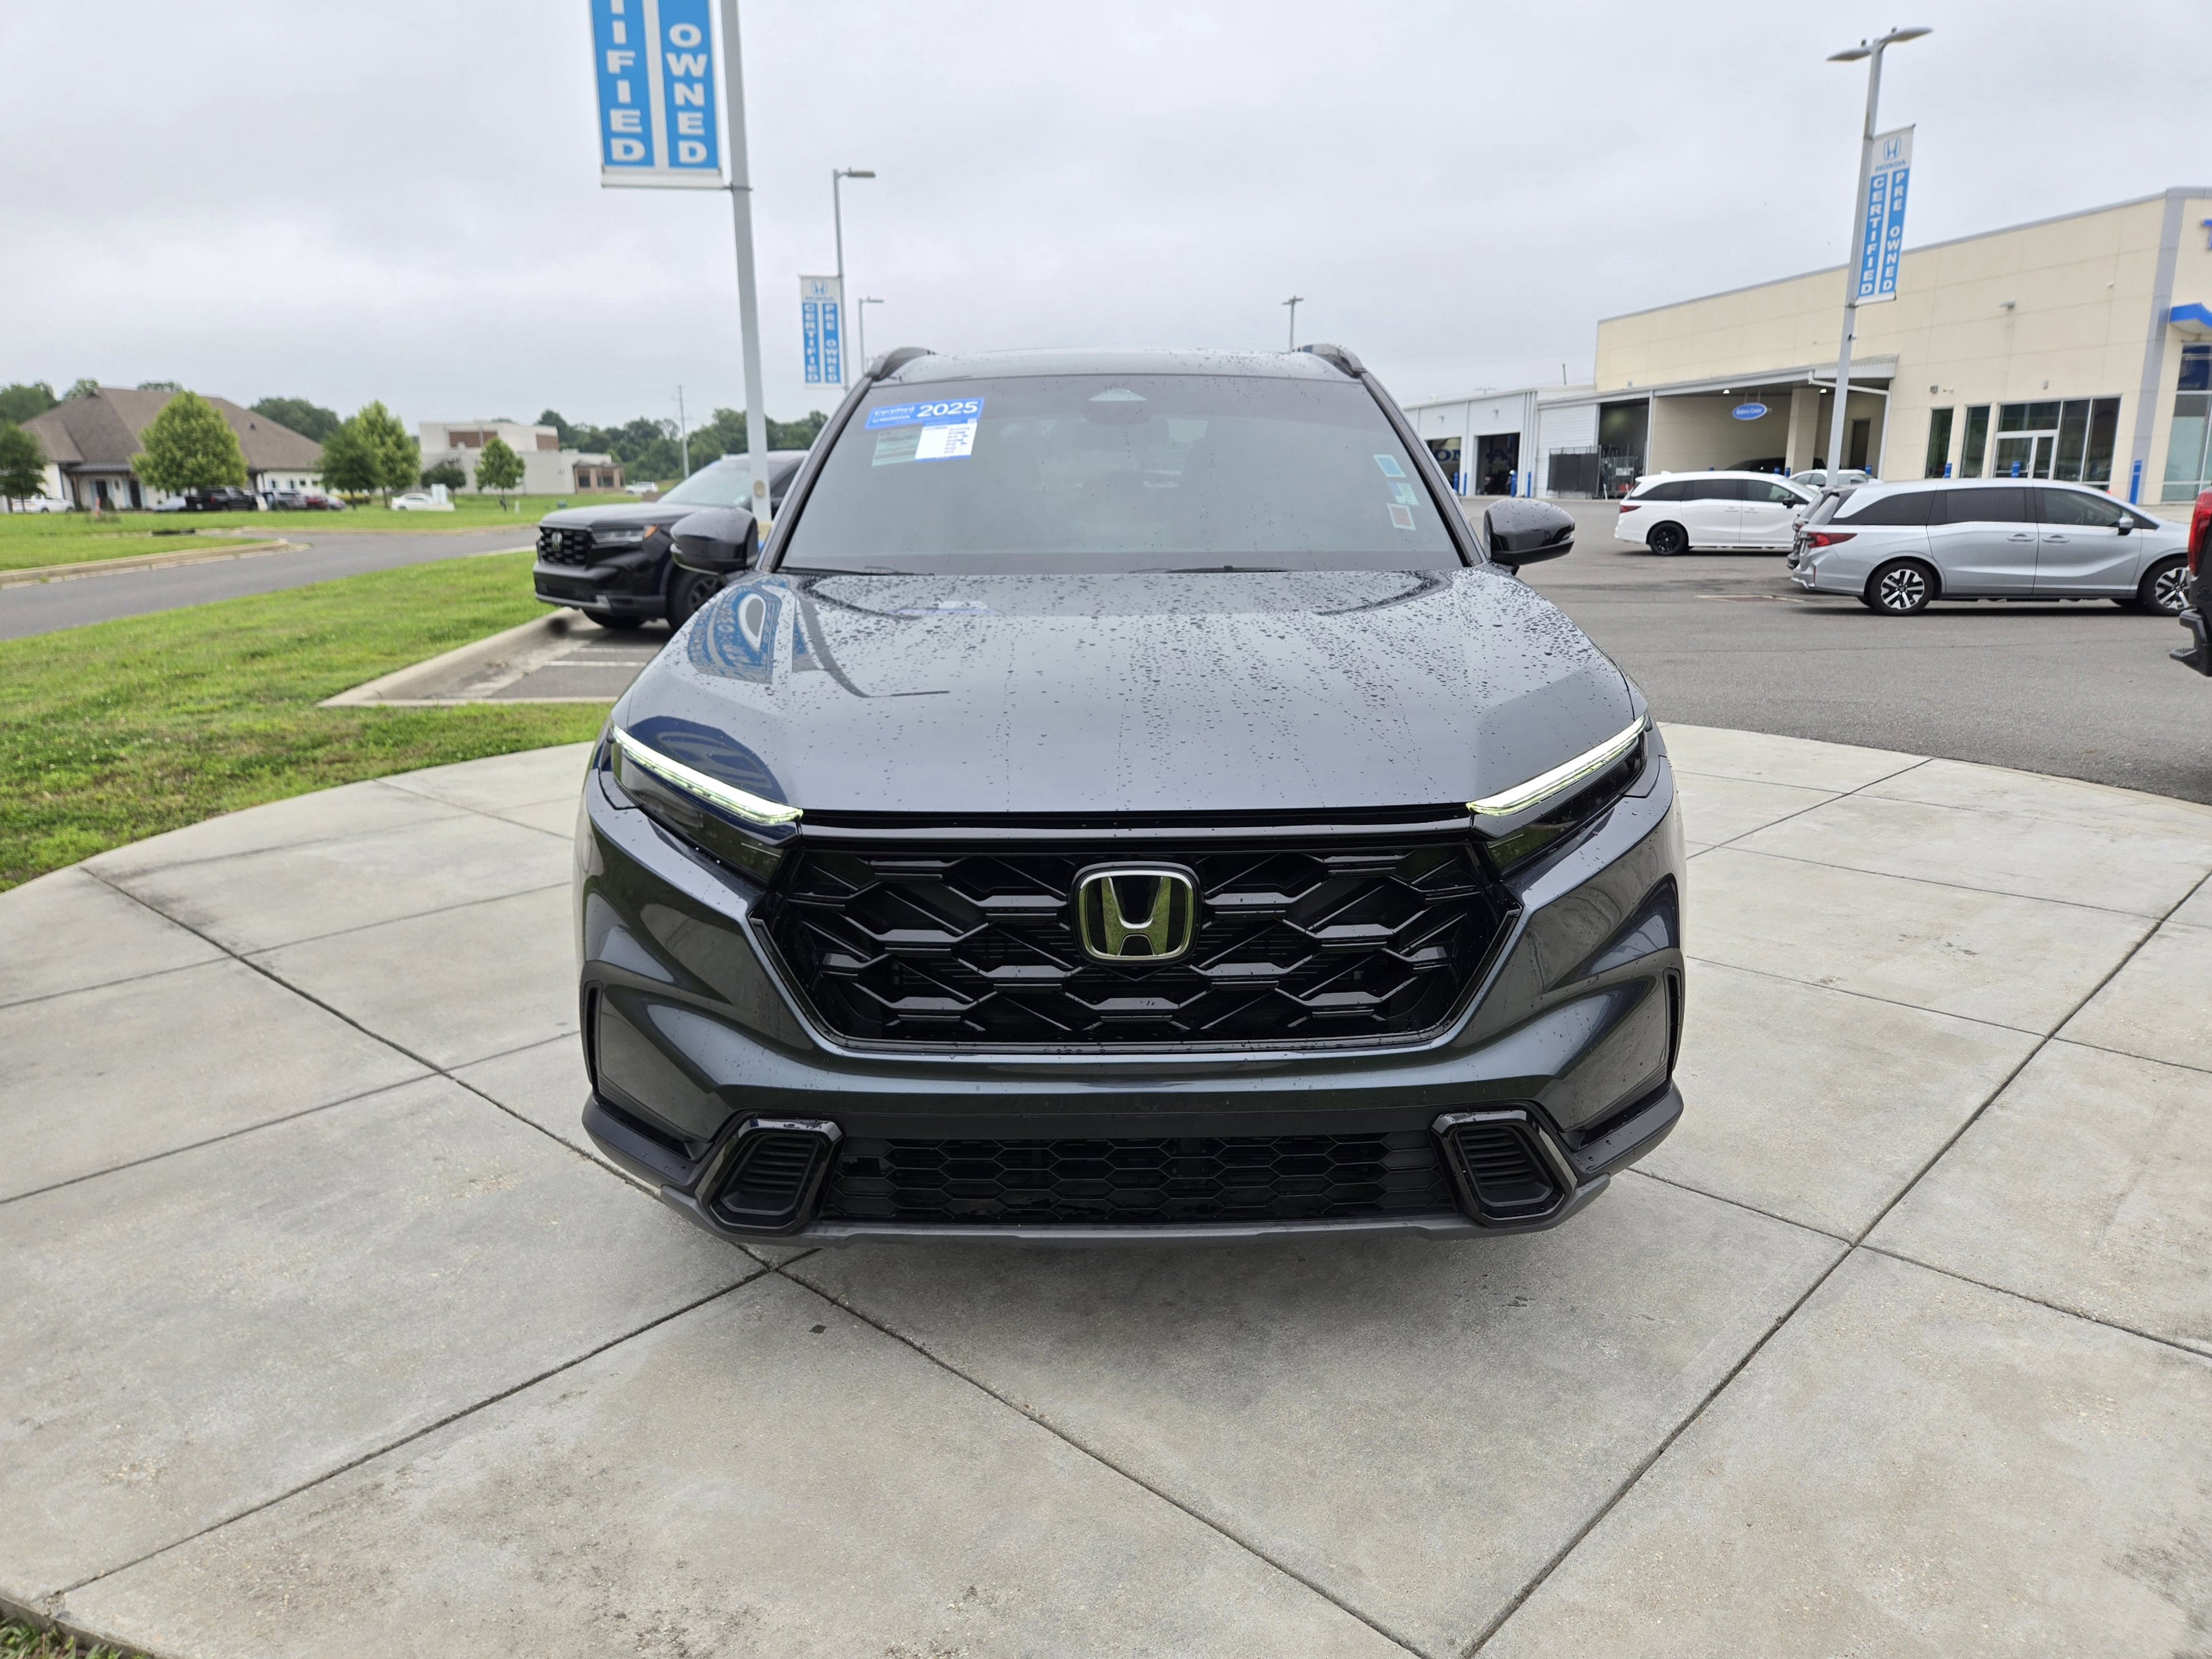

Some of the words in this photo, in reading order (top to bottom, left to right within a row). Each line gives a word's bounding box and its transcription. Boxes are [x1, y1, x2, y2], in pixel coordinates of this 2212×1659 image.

[666, 23, 707, 163] OWNED
[1875, 159, 1906, 172] HONDA
[1893, 172, 1905, 211] PRE
[1861, 176, 1885, 295] CERTIFIED
[1882, 226, 1900, 291] OWNED
[917, 401, 979, 418] 2025
